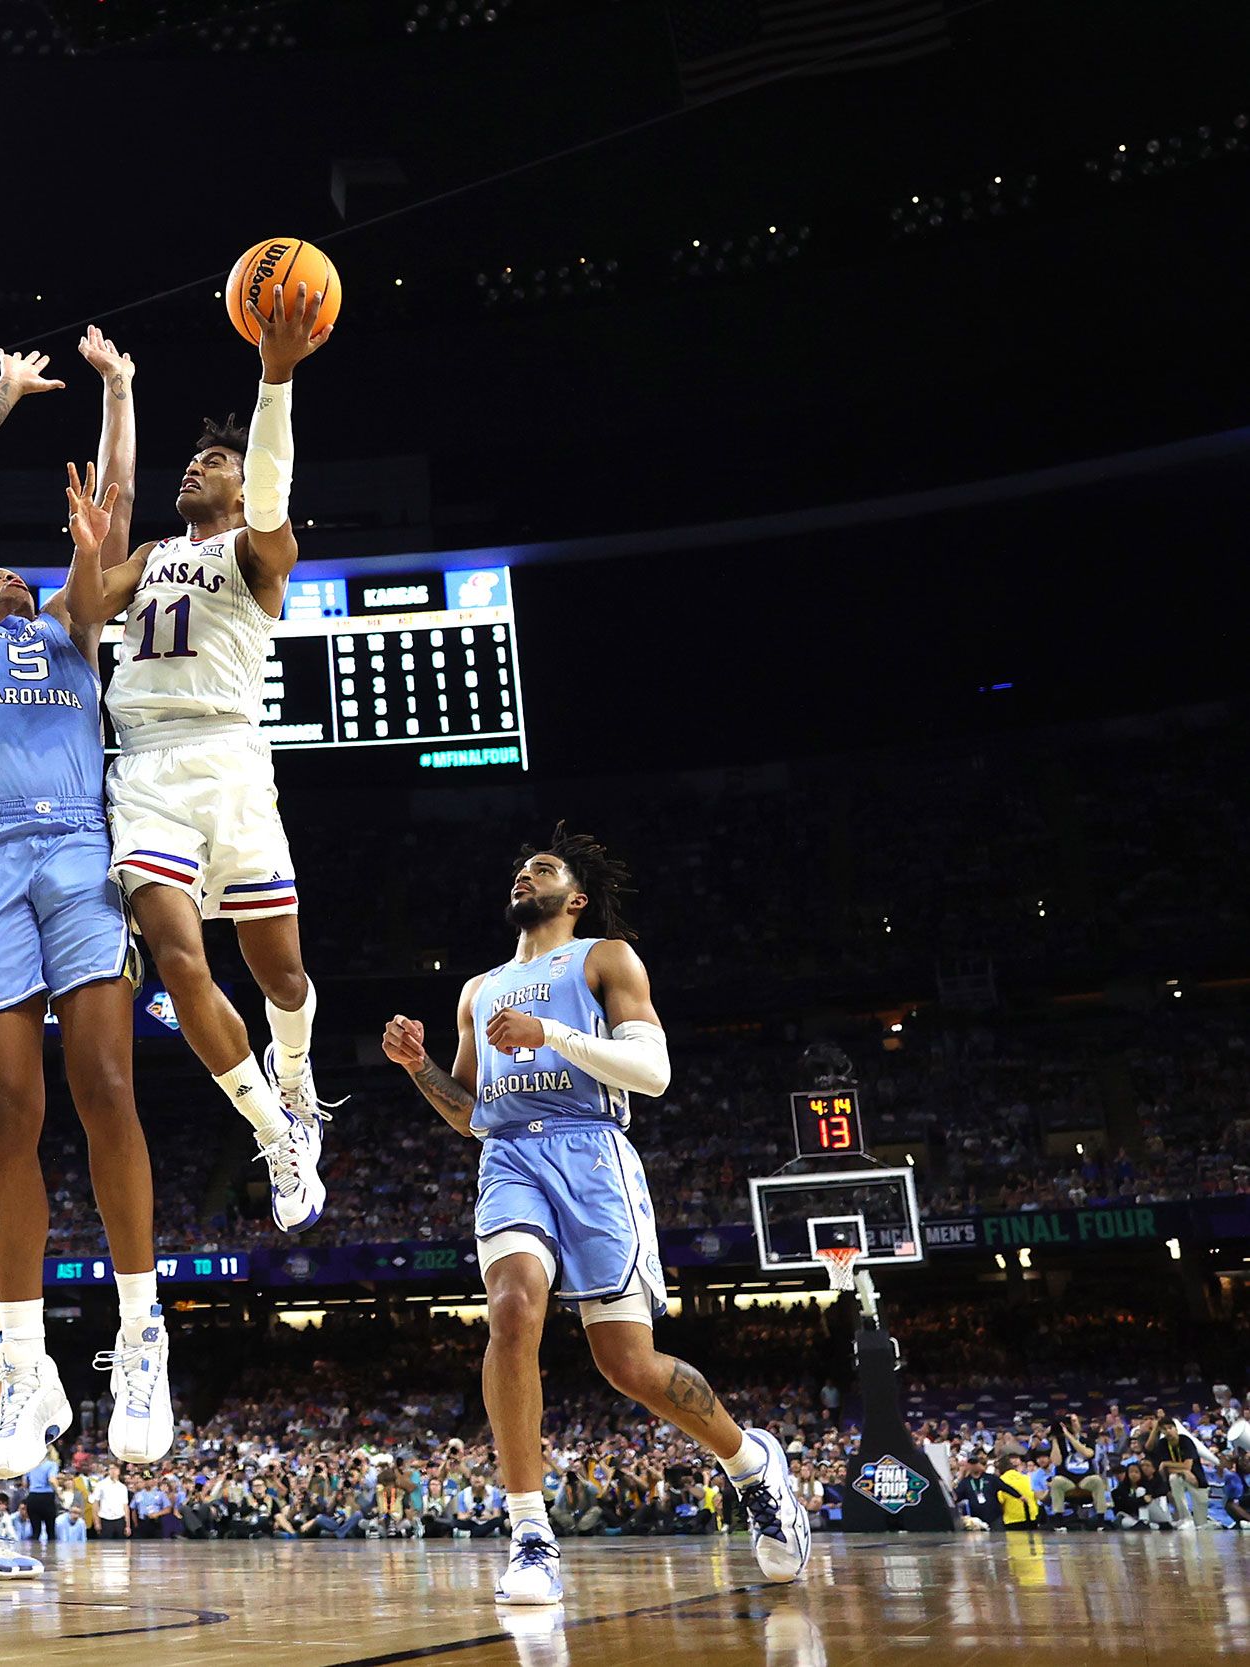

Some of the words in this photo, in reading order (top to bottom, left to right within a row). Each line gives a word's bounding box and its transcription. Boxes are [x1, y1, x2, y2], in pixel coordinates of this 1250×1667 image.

[142, 562, 227, 593] ANSAS
[363, 585, 429, 607] KANSAS
[132, 594, 198, 662] 11
[7, 639, 50, 681] 5
[419, 747, 519, 768] #MFINALFOUR
[491, 983, 551, 1015] NORTH
[482, 1070, 573, 1104] CAROLINA
[810, 1099, 851, 1116] 4:14
[819, 1116, 851, 1149] 13
[925, 1224, 976, 1243] MEN'S
[983, 1212, 1071, 1246] FINAL
[1078, 1207, 1156, 1240] FOUR
[56, 1262, 84, 1279] AST
[193, 1258, 212, 1275] TO
[220, 1257, 238, 1275] 11
[413, 1250, 458, 1270] 2022
[875, 1467, 909, 1482] FINAL
[874, 1482, 908, 1497] FOUR
